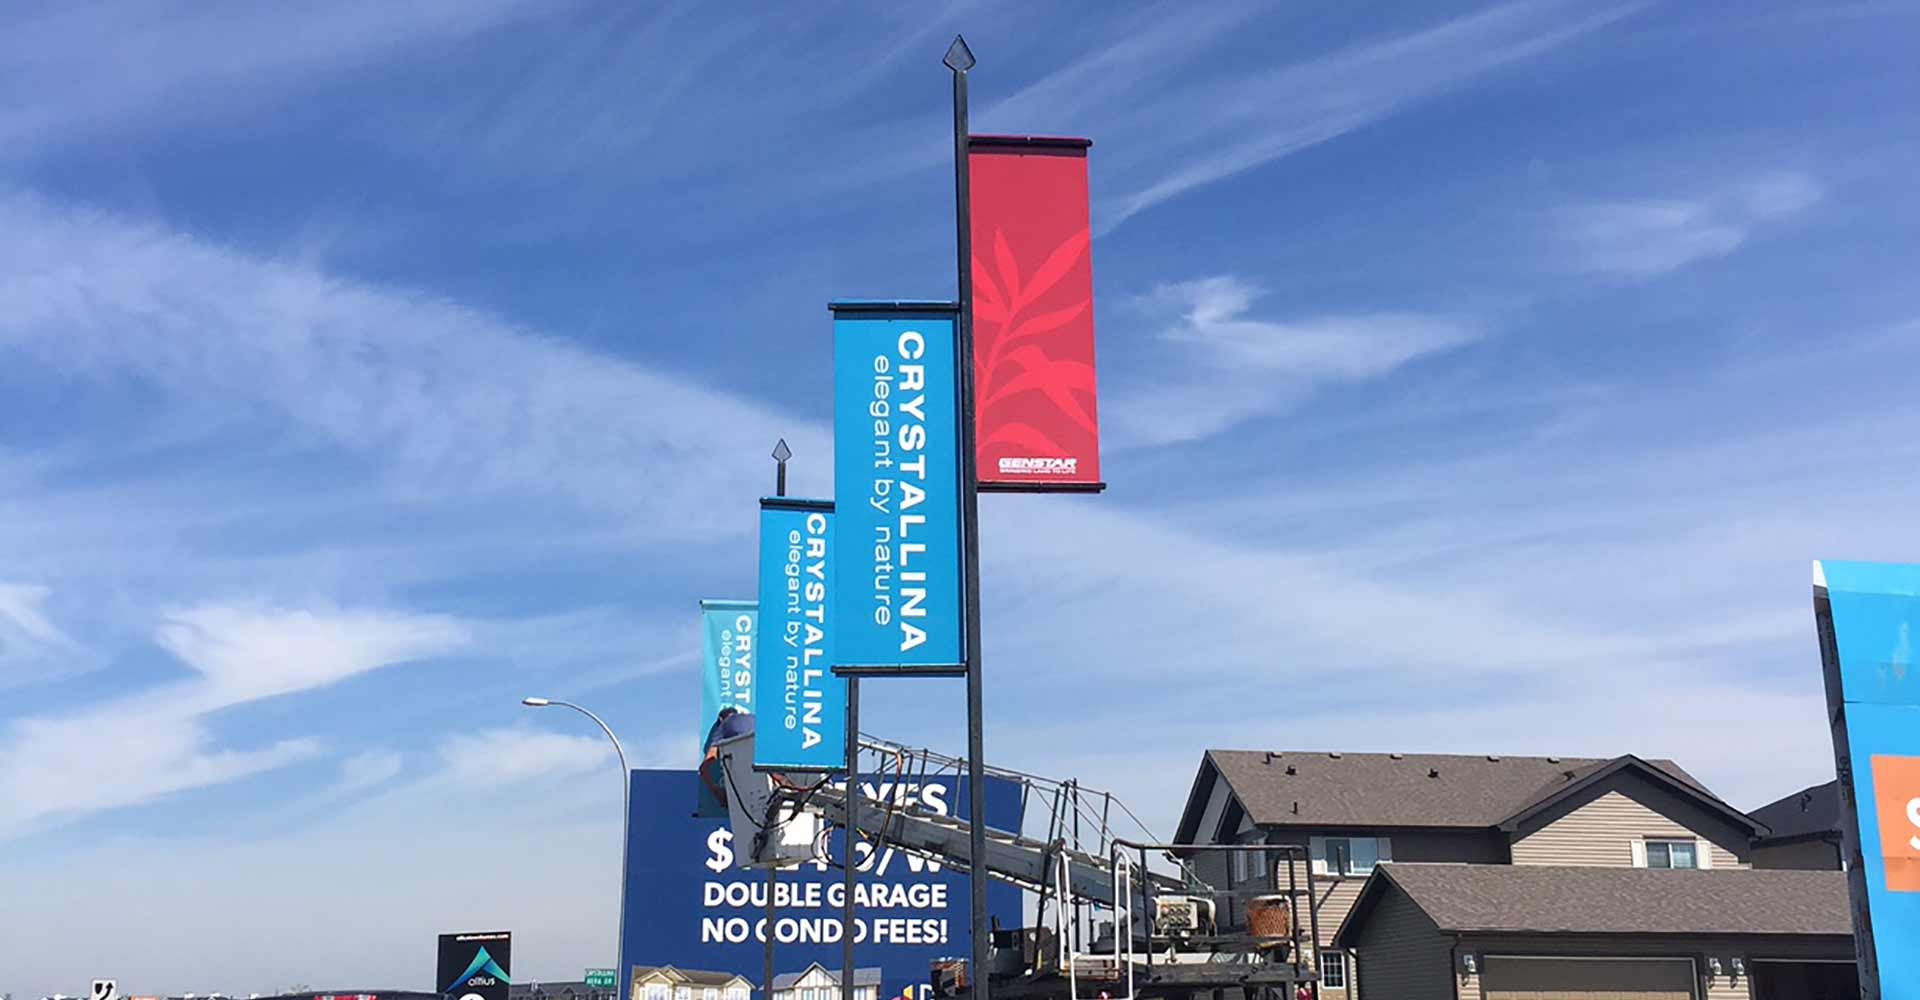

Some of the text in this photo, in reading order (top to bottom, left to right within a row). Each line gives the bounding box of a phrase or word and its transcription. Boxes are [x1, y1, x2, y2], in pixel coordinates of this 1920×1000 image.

[869, 354, 894, 626] elegant by nature
[897, 331, 927, 652] CRYSTALLINA
[998, 457, 1077, 469] GENSTAR
[718, 629, 733, 697] elegant
[783, 529, 804, 730] elegant by nature
[801, 513, 827, 750] CRYSTALLINA
[702, 917, 749, 943] NO
[874, 918, 948, 943] FEES!
[704, 882, 947, 908] DOUBLE GARAGE
